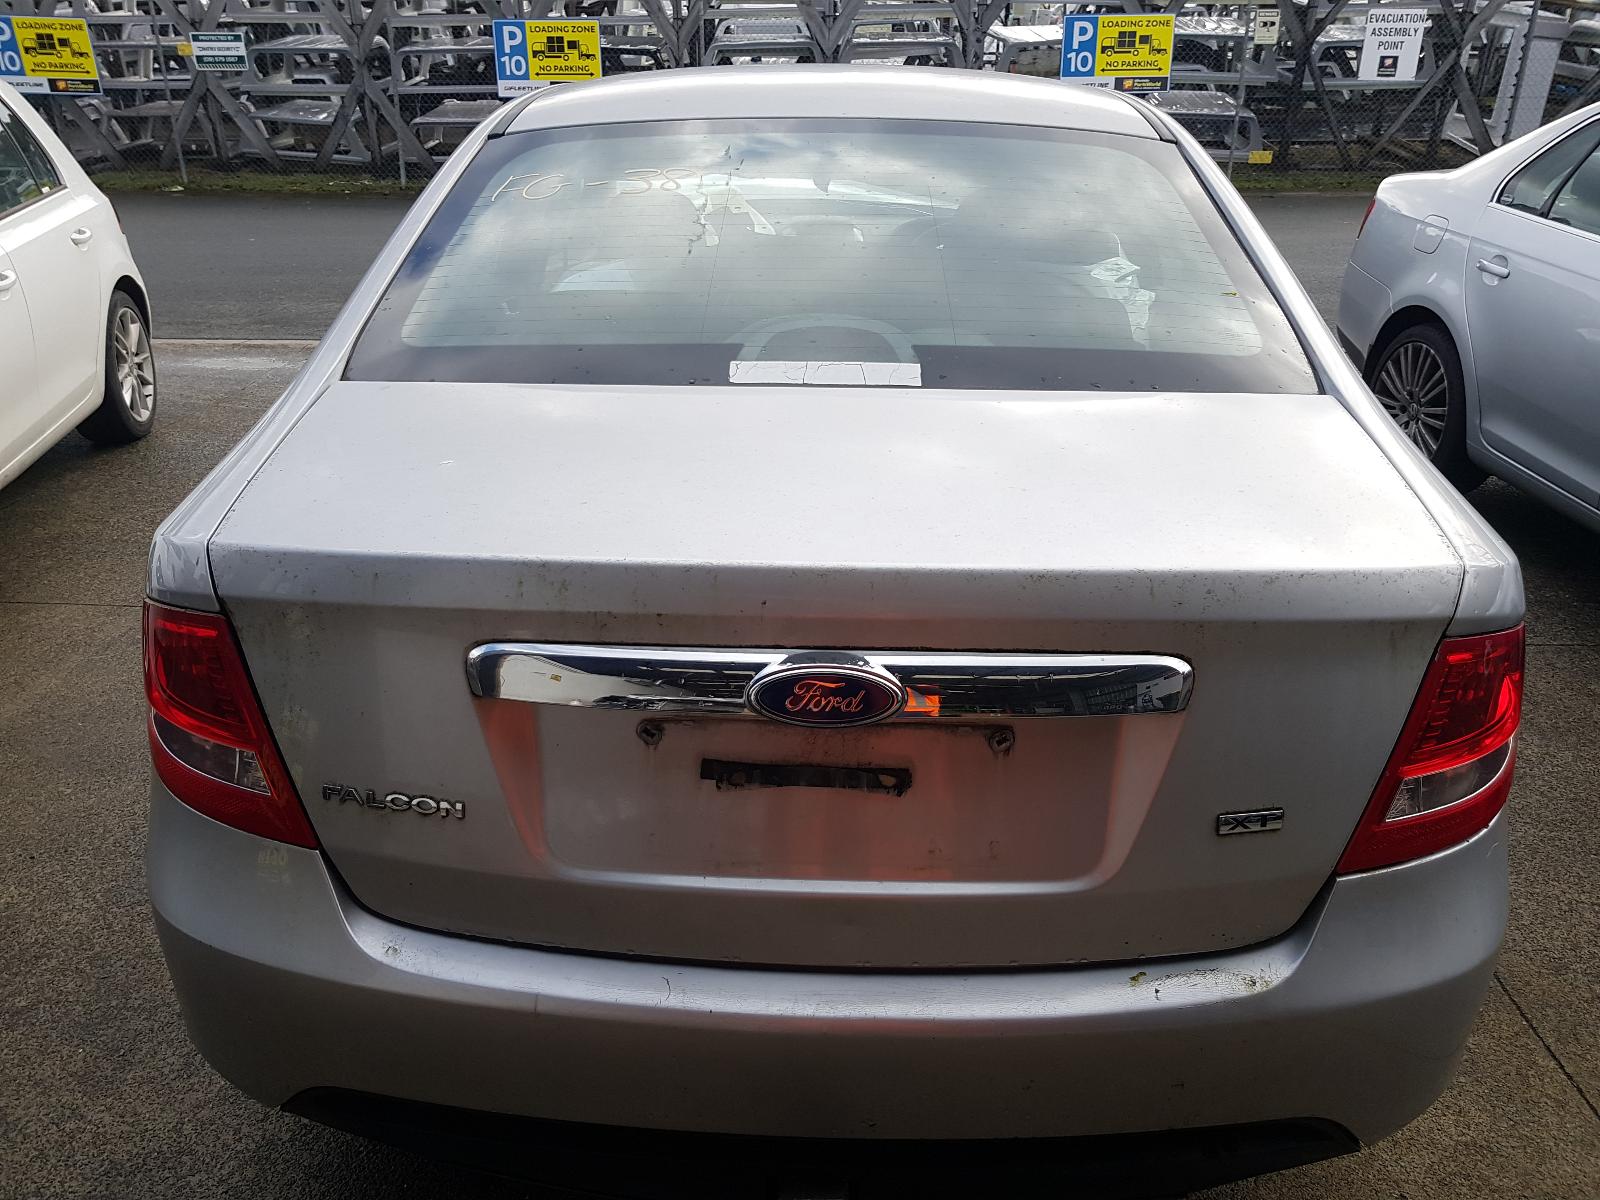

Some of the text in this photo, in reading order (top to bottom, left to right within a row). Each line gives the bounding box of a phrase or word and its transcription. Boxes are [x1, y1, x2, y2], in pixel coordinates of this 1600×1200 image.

[16, 21, 84, 31] LOADING ZONE
[1102, 19, 1171, 28] LOADING ZONE
[1369, 13, 1426, 24] EVACUATION
[503, 26, 523, 53] P
[1072, 21, 1094, 49] P
[1370, 27, 1420, 37] ASSEMBLY
[1377, 41, 1405, 51] POINT
[500, 55, 526, 75] 10
[1067, 51, 1093, 72] 10
[1121, 60, 1159, 68] PARKING
[785, 680, 866, 712] Ford
[322, 783, 466, 819] FALCON
[1223, 811, 1282, 832] XT
